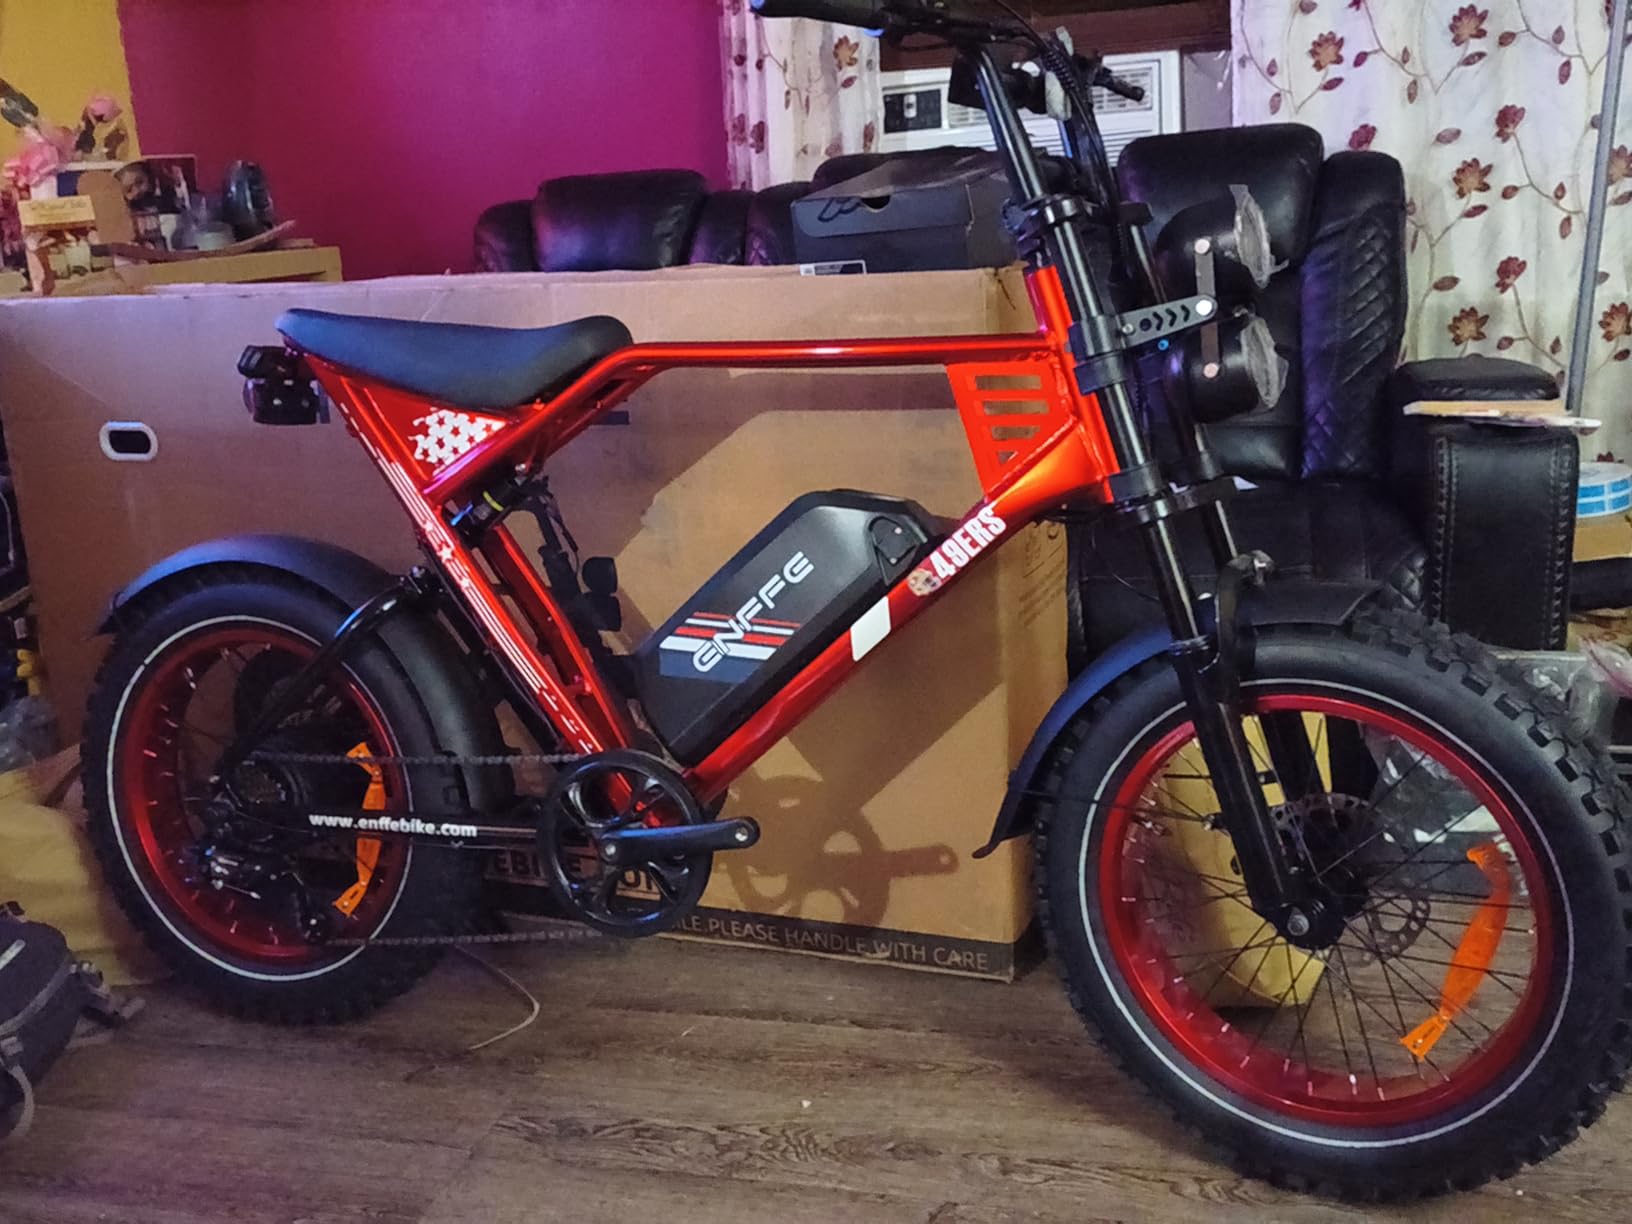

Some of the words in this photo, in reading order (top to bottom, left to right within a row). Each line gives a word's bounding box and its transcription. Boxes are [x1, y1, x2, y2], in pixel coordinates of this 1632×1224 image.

[930, 505, 1007, 579] 49ERS
[308, 814, 478, 838] www.enffebike.com
[708, 917, 779, 942] PLEASE
[784, 927, 866, 954] HANDLE
[872, 939, 926, 962] WITH
[933, 947, 989, 971] CARE
